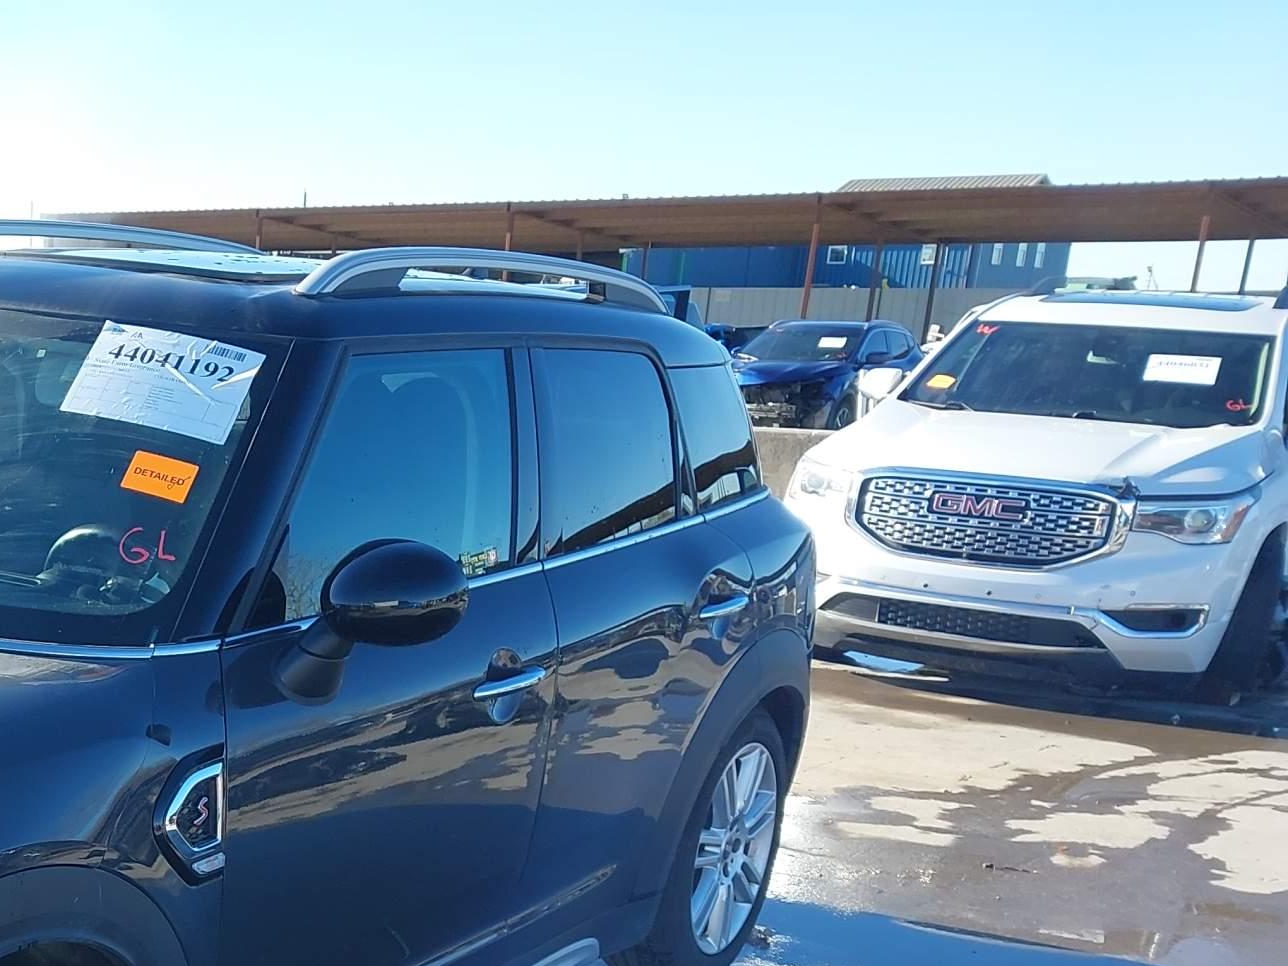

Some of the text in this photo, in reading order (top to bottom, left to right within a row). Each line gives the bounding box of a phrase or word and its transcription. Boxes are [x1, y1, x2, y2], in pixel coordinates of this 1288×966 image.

[108, 343, 235, 382] 44041192
[133, 466, 185, 486] DETAILED
[933, 493, 1026, 520] GMC
